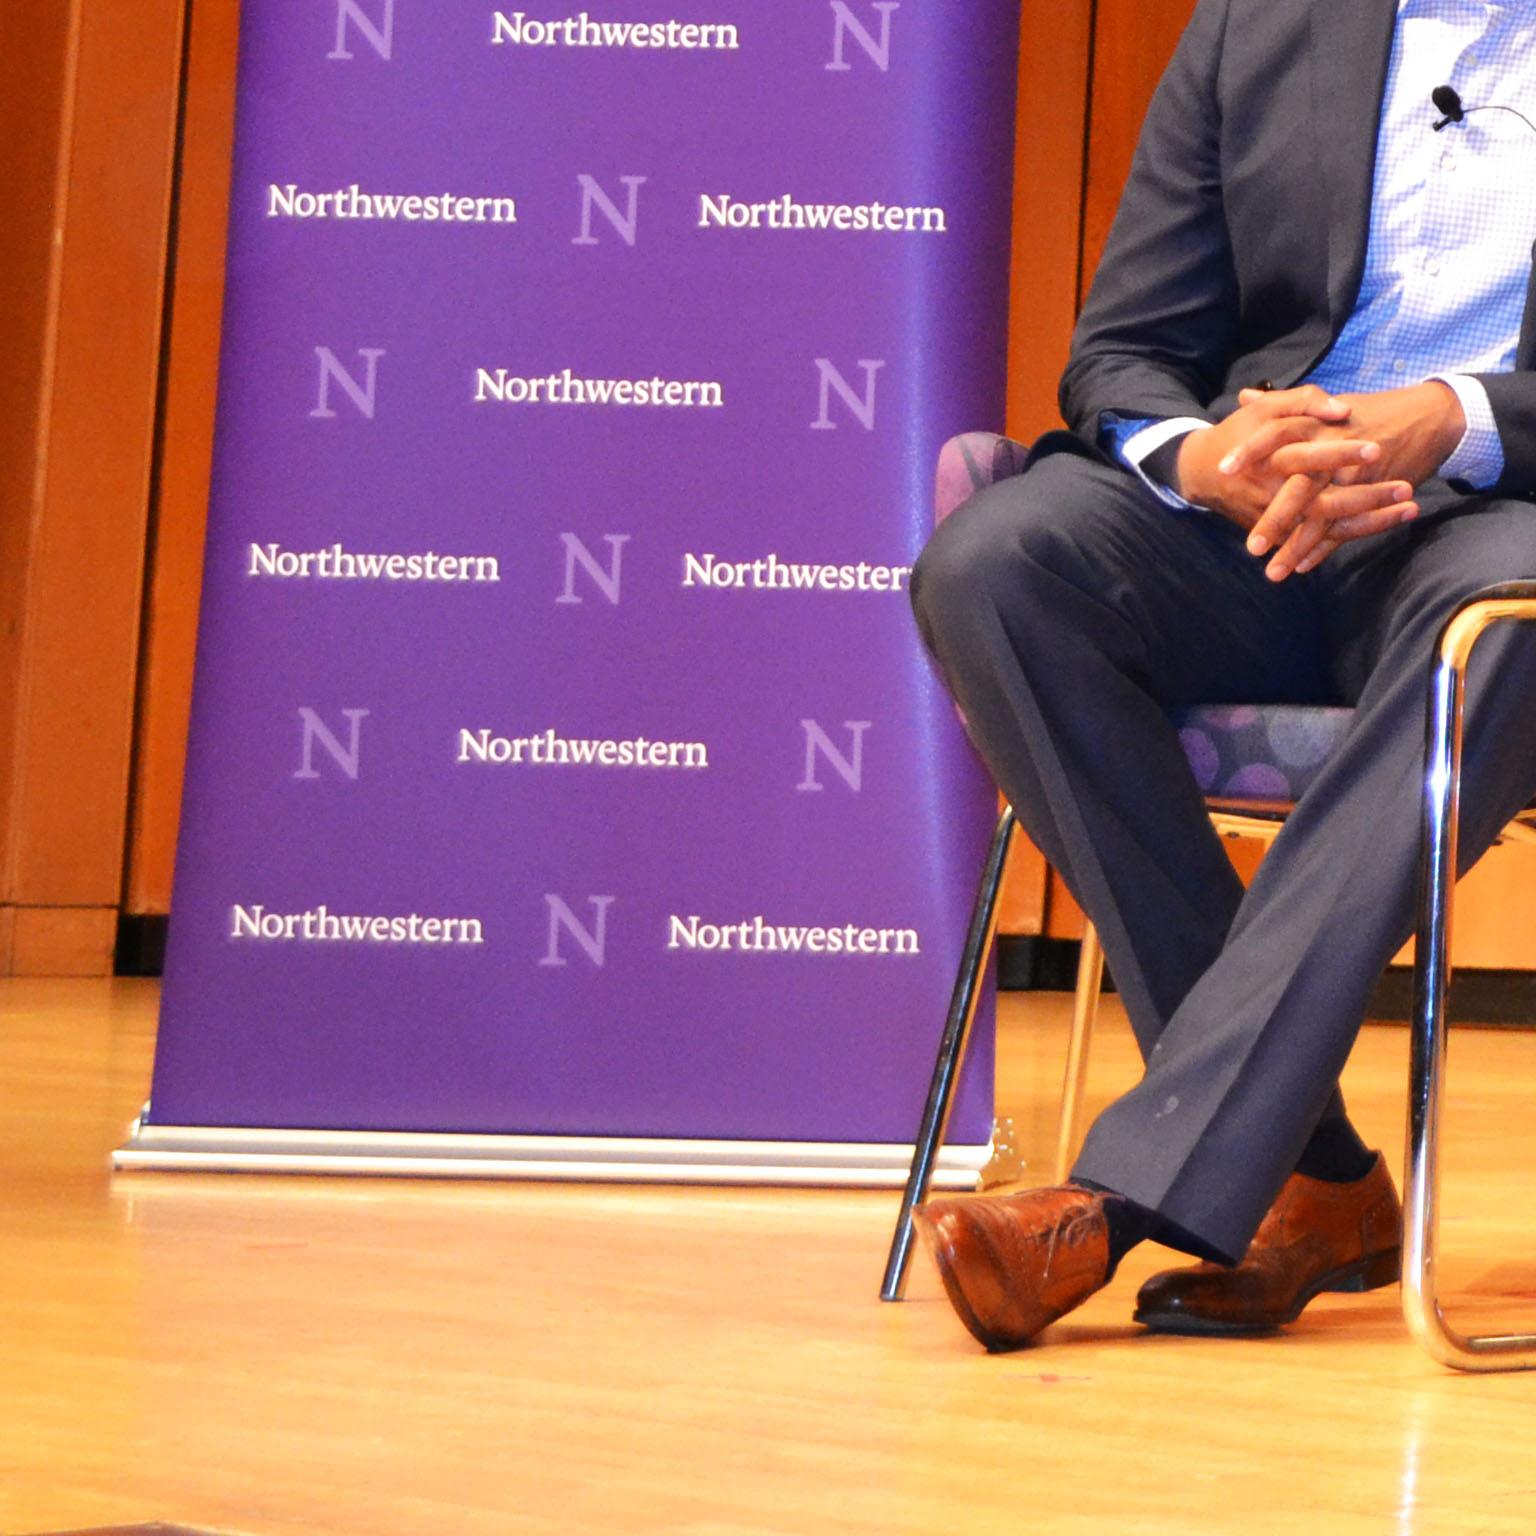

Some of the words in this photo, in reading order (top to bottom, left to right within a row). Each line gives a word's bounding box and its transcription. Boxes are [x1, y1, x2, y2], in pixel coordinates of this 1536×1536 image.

[489, 10, 740, 50] Northwestern
[824, 0, 900, 72] N
[265, 183, 518, 224] Northwestern
[571, 174, 647, 246] N
[696, 193, 948, 233] Northwestern
[309, 346, 385, 419] N
[472, 367, 725, 409] Northwestern
[810, 358, 885, 430] N
[246, 542, 501, 583] Northwestern
[555, 532, 631, 605] N
[680, 551, 915, 593] Northwester
[293, 707, 369, 779] N
[456, 727, 709, 770] Northwestern
[796, 719, 871, 791] N
[229, 903, 485, 946] Northwestern
[540, 894, 615, 966] N
[666, 914, 921, 957] Northwestern
